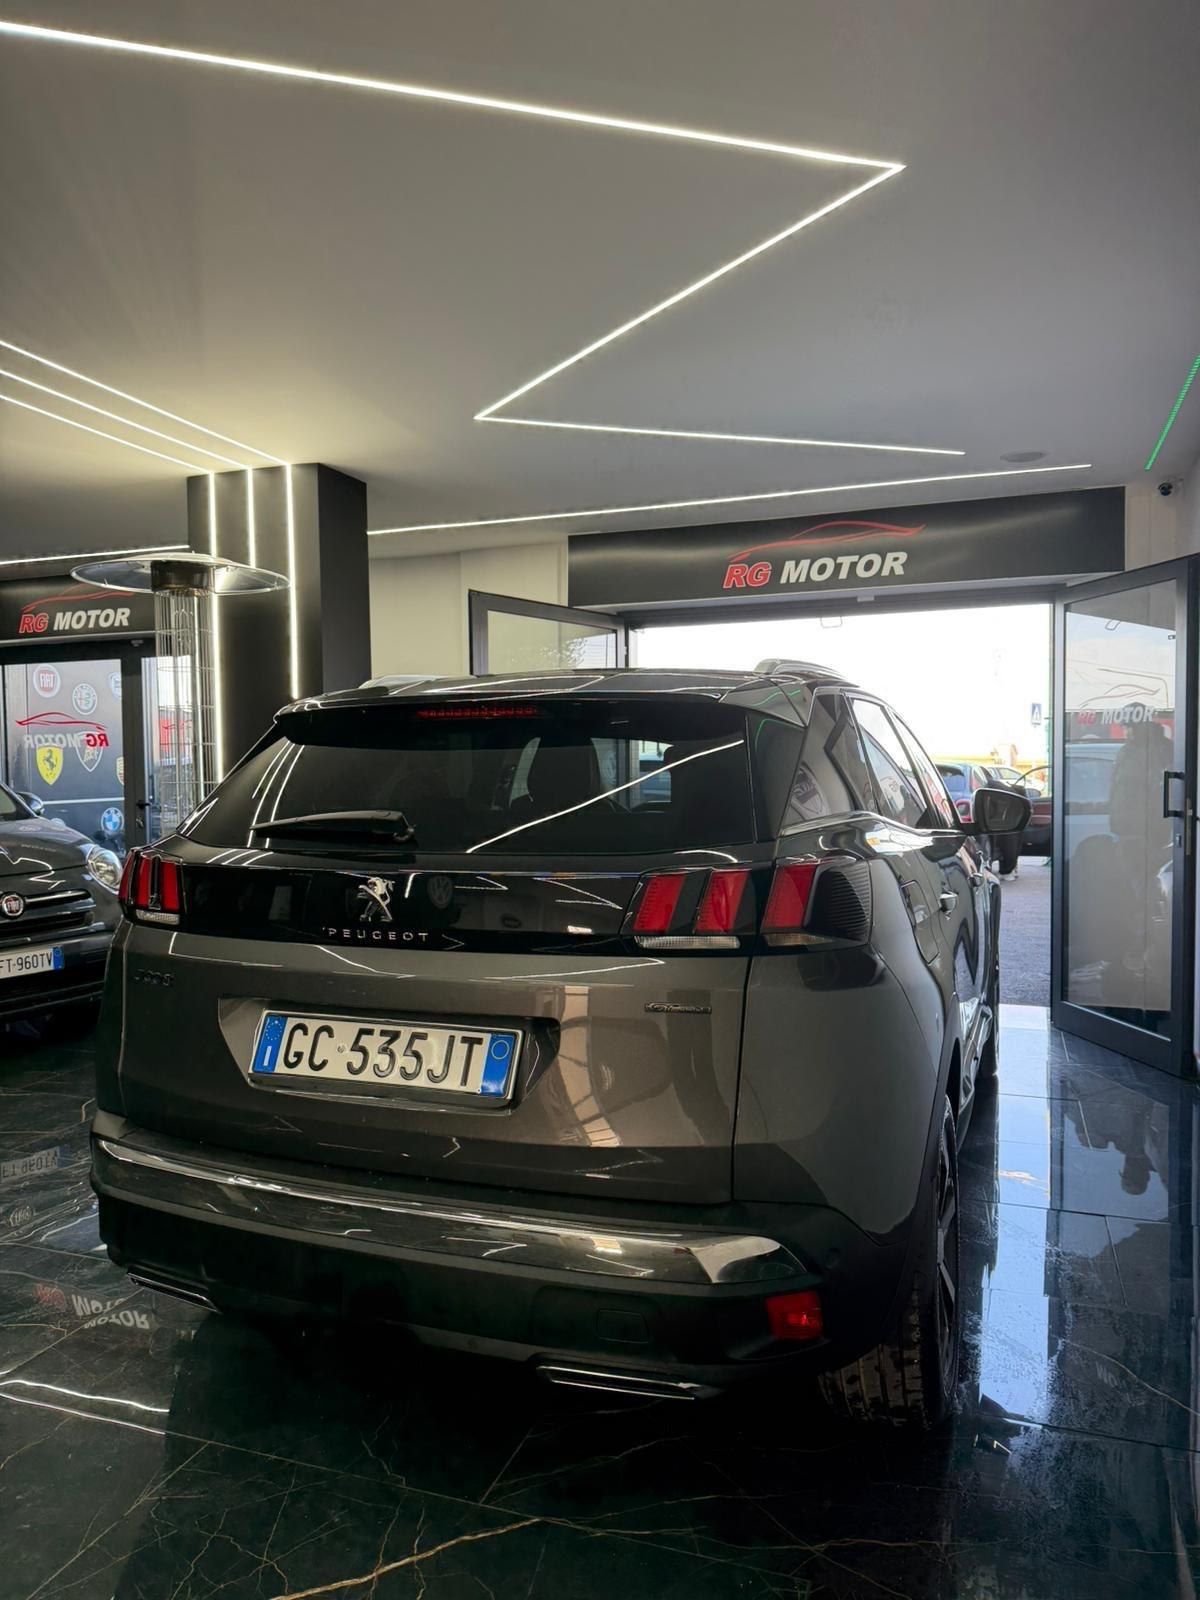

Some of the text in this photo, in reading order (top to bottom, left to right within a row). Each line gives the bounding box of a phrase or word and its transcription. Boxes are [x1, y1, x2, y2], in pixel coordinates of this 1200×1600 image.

[723, 551, 908, 588] RG MOTOR
[18, 607, 131, 634] RG MOTOR
[1101, 705, 1155, 724] MOTOR
[322, 926, 429, 942] PEUGEOT
